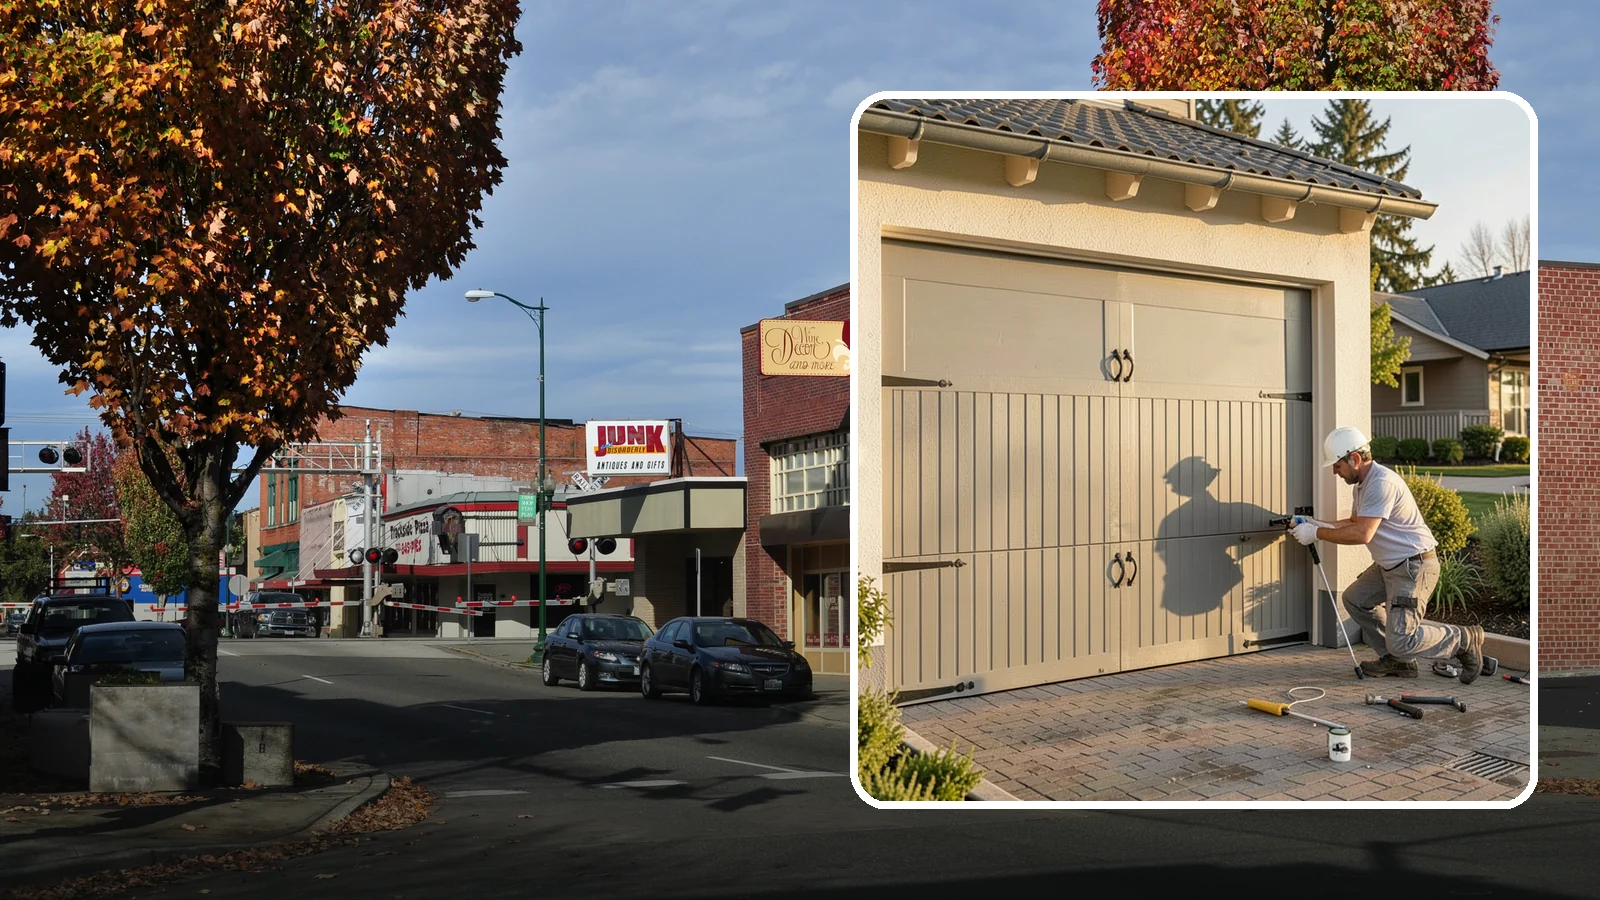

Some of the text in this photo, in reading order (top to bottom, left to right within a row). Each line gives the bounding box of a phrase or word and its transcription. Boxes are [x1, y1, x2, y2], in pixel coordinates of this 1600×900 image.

[595, 425, 664, 457] JUNK
[607, 445, 645, 454] DISORDERLY
[597, 460, 665, 470] ANTIQUES AND GIFTS
[414, 519, 429, 534] Pizza
